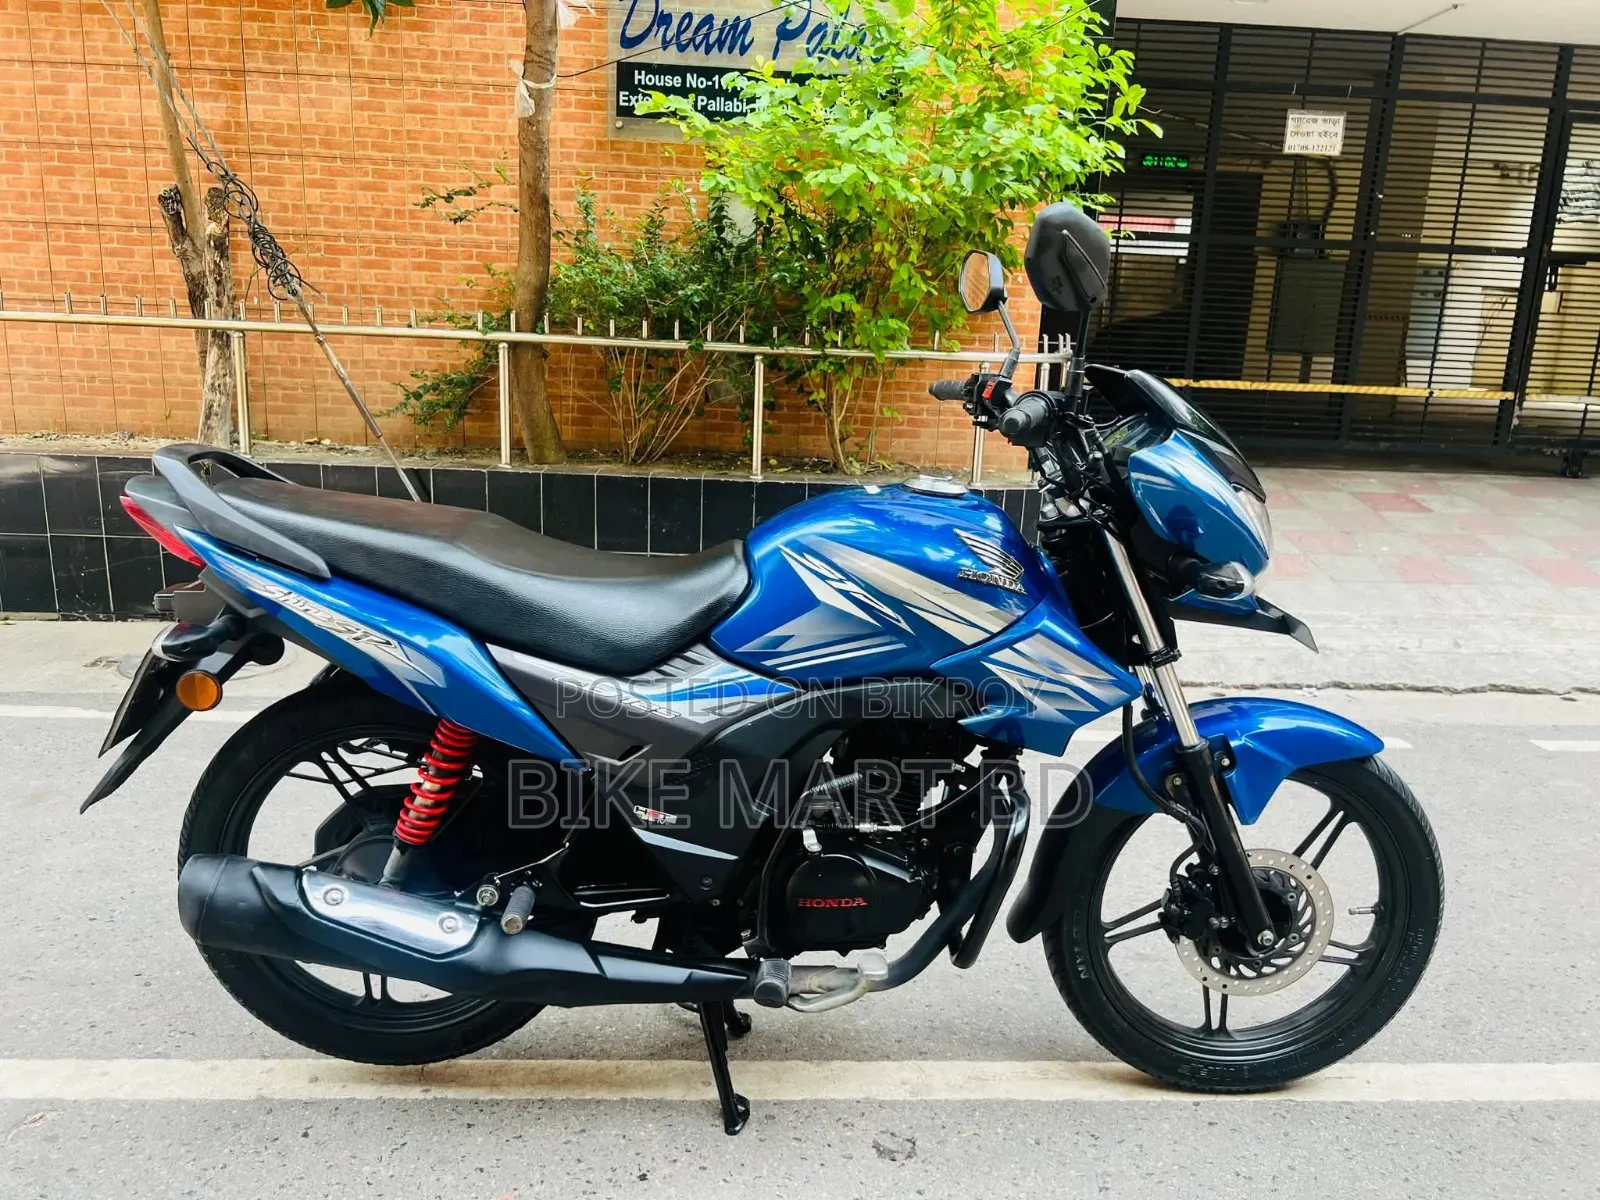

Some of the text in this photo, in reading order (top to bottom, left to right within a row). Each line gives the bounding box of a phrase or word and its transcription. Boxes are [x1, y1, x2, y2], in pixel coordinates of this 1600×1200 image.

[634, 69, 682, 87] House
[956, 568, 1028, 595] HONDA
[797, 897, 868, 908] HONDA
